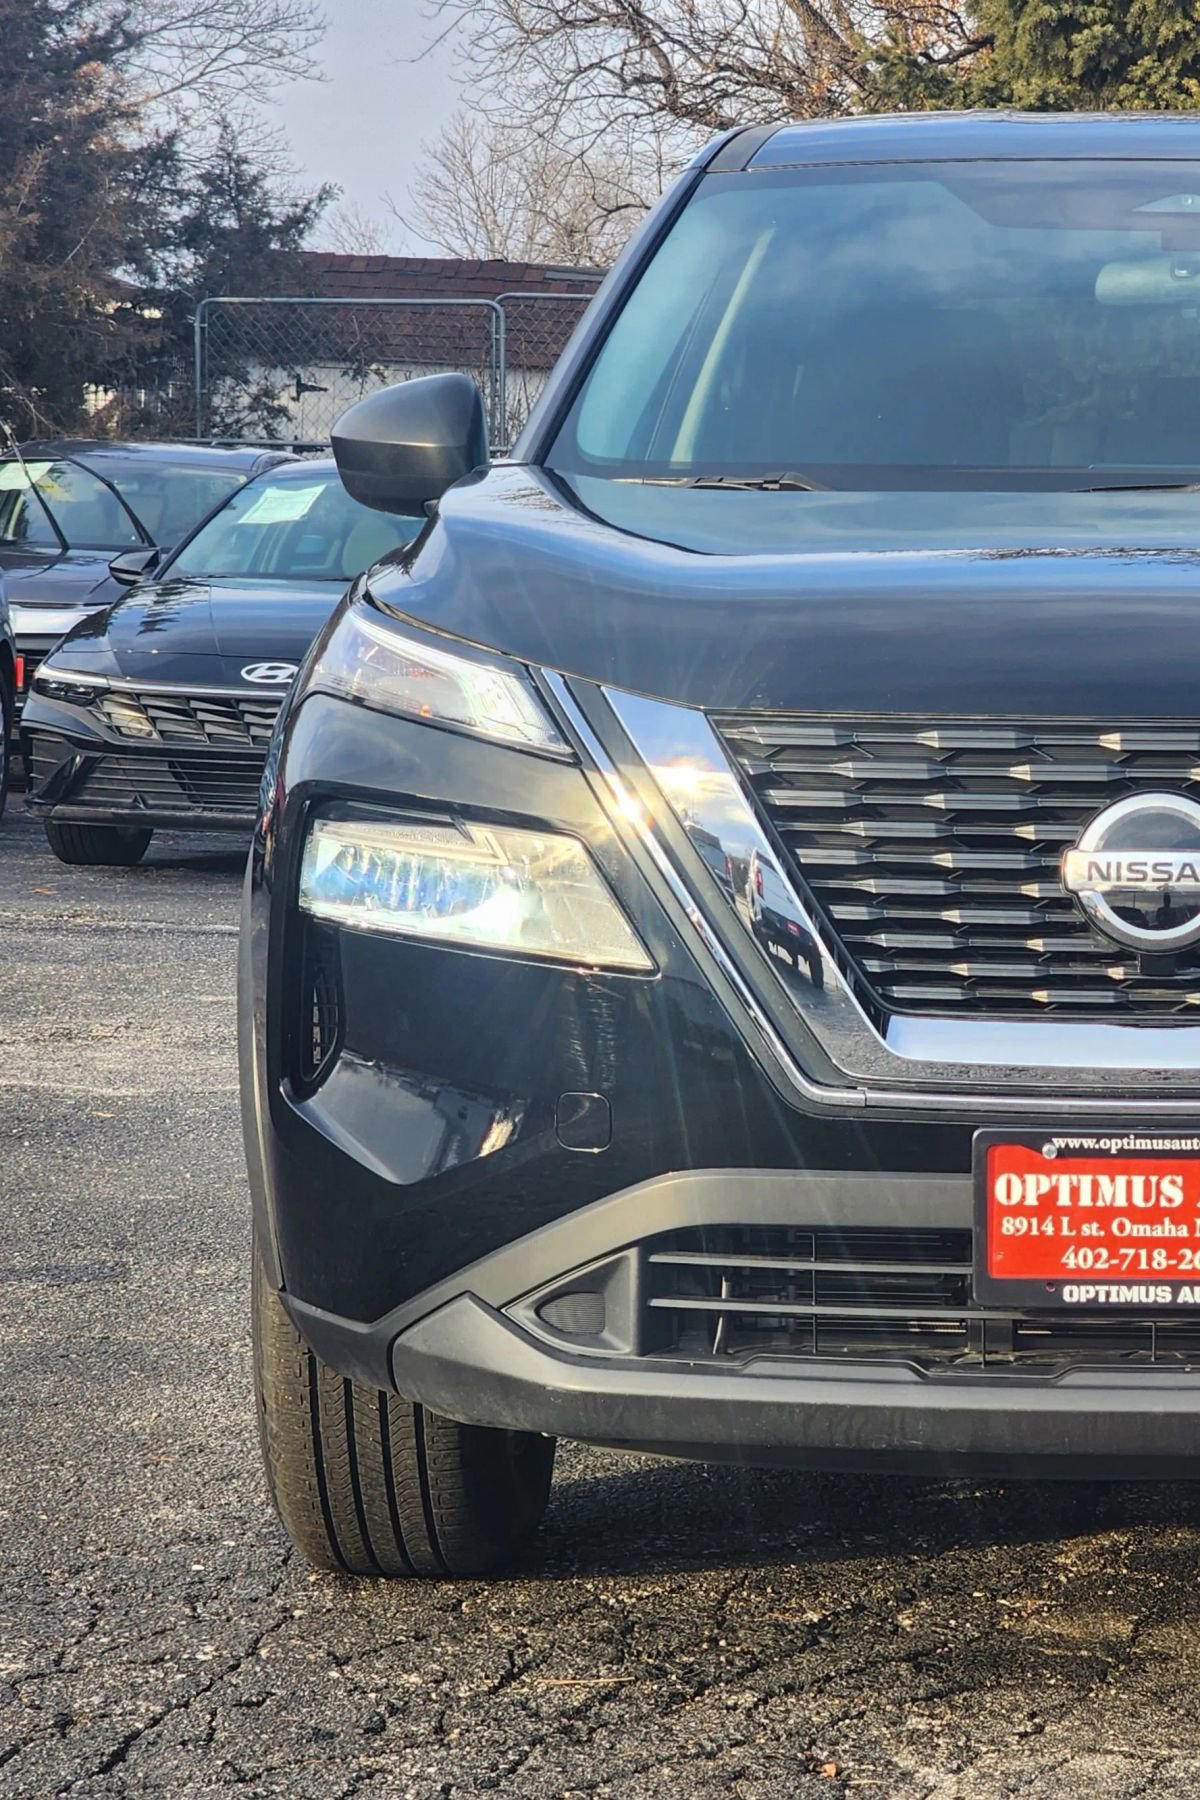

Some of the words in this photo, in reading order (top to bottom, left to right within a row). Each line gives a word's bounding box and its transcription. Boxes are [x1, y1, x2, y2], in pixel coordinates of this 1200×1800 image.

[994, 1173, 1184, 1207] OPTIMUS
[1001, 1216, 1055, 1236] 8914
[1060, 1217, 1077, 1236] L
[1081, 1219, 1105, 1237] st.
[1111, 1217, 1189, 1238] Omaha
[1062, 1284, 1173, 1303] OPTIMUS
